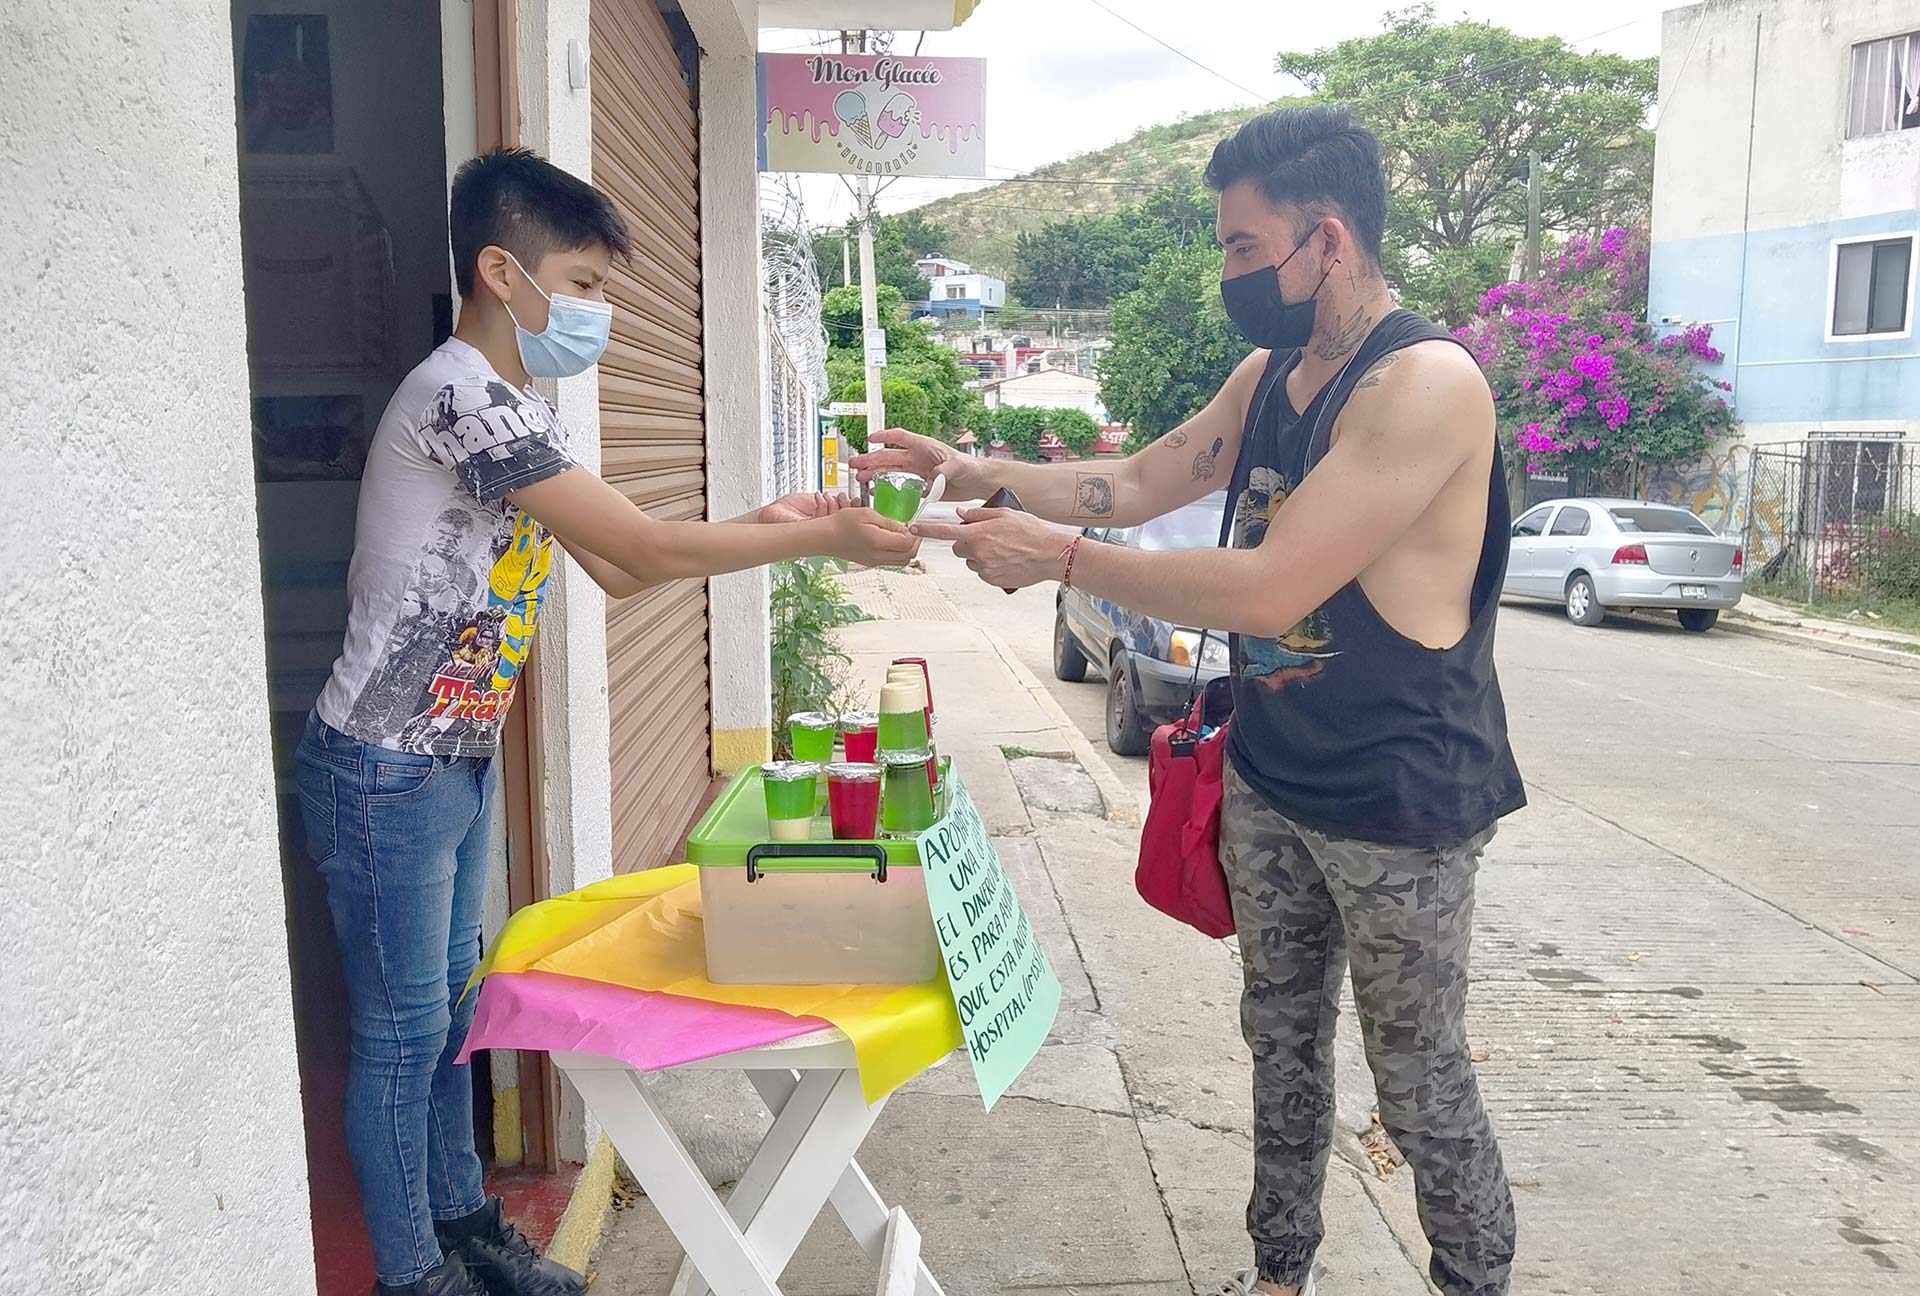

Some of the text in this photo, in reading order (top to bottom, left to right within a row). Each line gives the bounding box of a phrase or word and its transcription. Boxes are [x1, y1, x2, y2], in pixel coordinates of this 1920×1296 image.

[807, 56, 941, 91] Mon Glacée
[832, 406, 869, 415] TLACOLU
[948, 848, 981, 892] UNA
[937, 912, 961, 948] EL
[949, 951, 970, 982] ES
[971, 913, 1005, 965] PARA
[958, 981, 990, 1028] QUE
[969, 992, 1026, 1064] HOSPITAL
